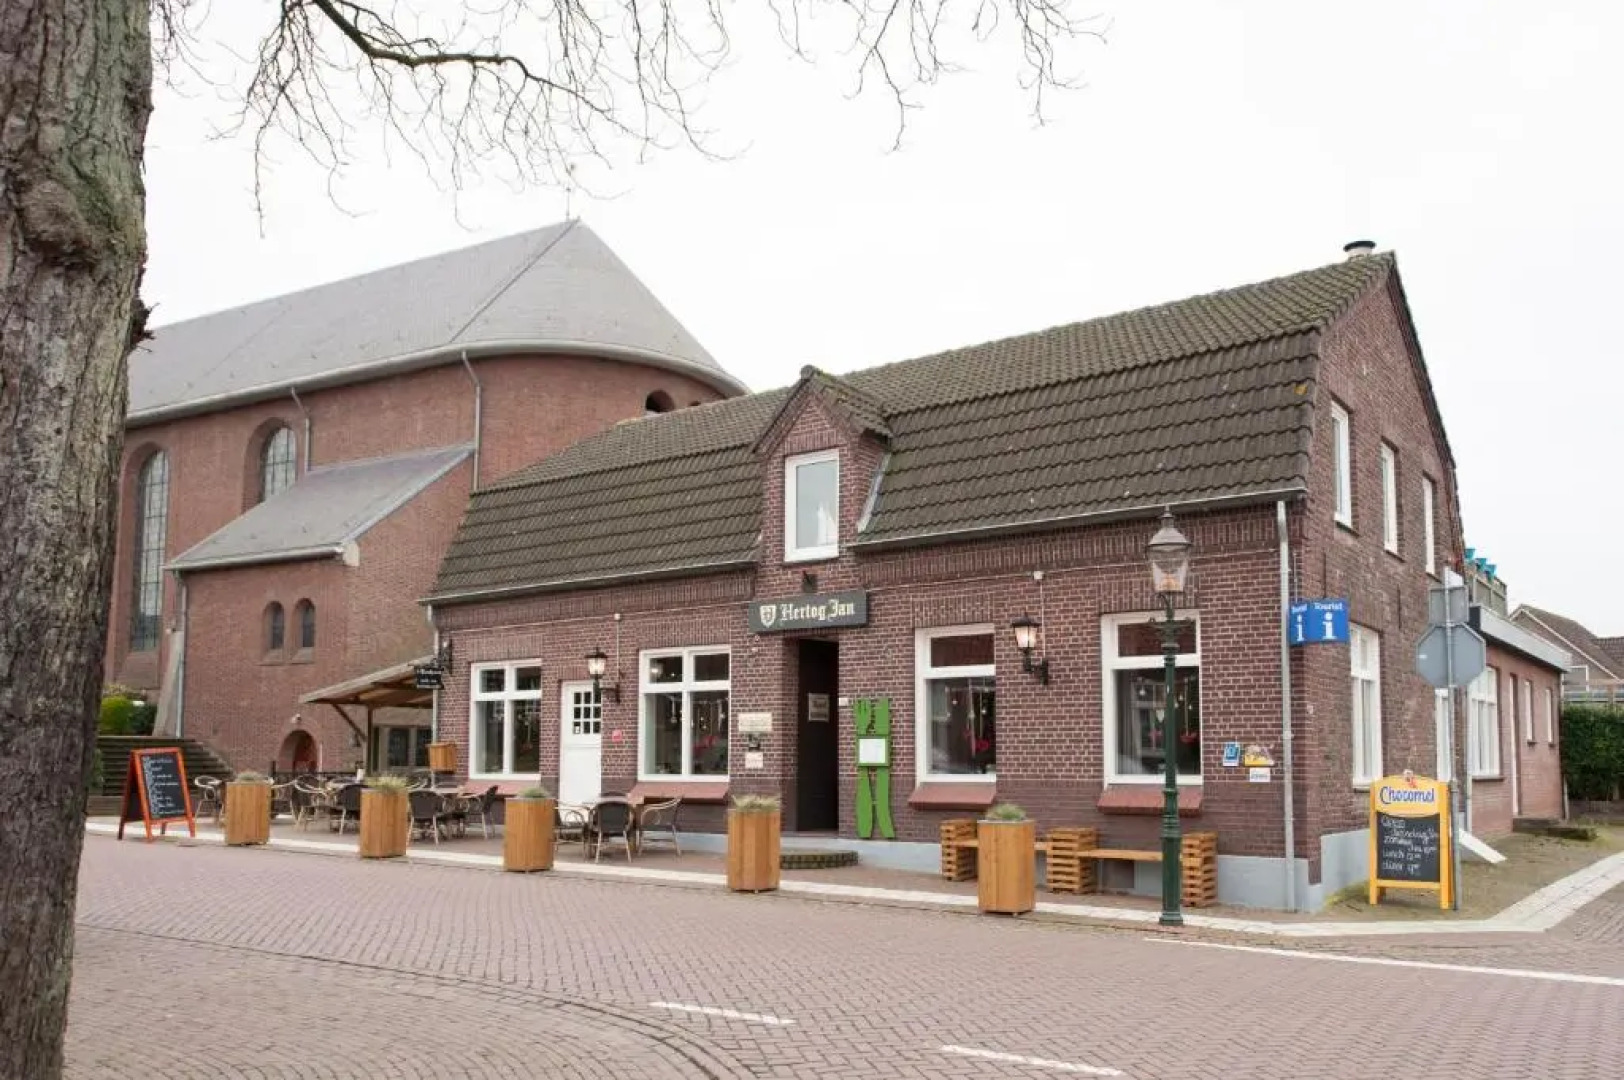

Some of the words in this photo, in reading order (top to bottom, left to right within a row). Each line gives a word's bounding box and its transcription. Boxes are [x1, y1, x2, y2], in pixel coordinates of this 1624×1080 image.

[780, 603, 826, 621] Hertog
[828, 598, 856, 621] Jan
[1314, 602, 1343, 610] Tourist
[1380, 786, 1434, 804] Chocomel
